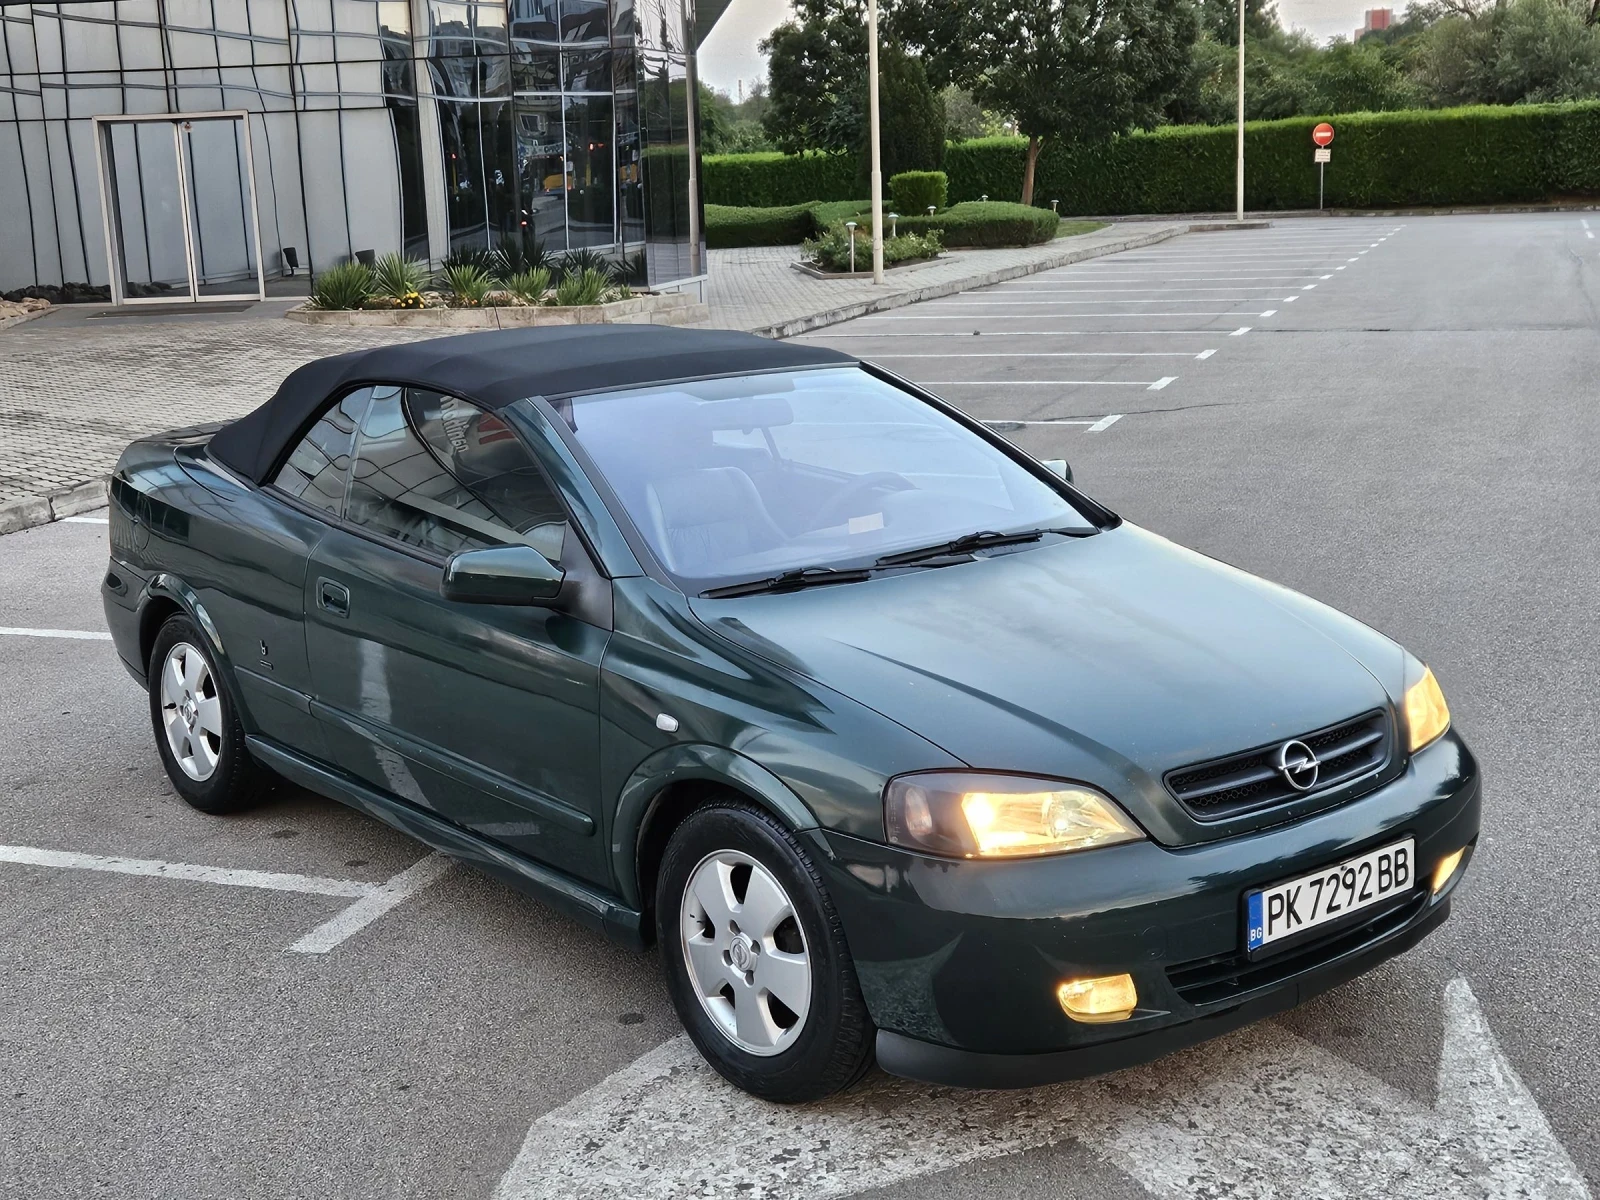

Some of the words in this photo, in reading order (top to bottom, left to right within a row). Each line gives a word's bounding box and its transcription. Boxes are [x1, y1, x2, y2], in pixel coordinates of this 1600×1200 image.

[1268, 885, 1303, 936] PK
[1309, 861, 1373, 921] 7292
[1378, 847, 1409, 895] BB
[1250, 927, 1263, 941] BG
